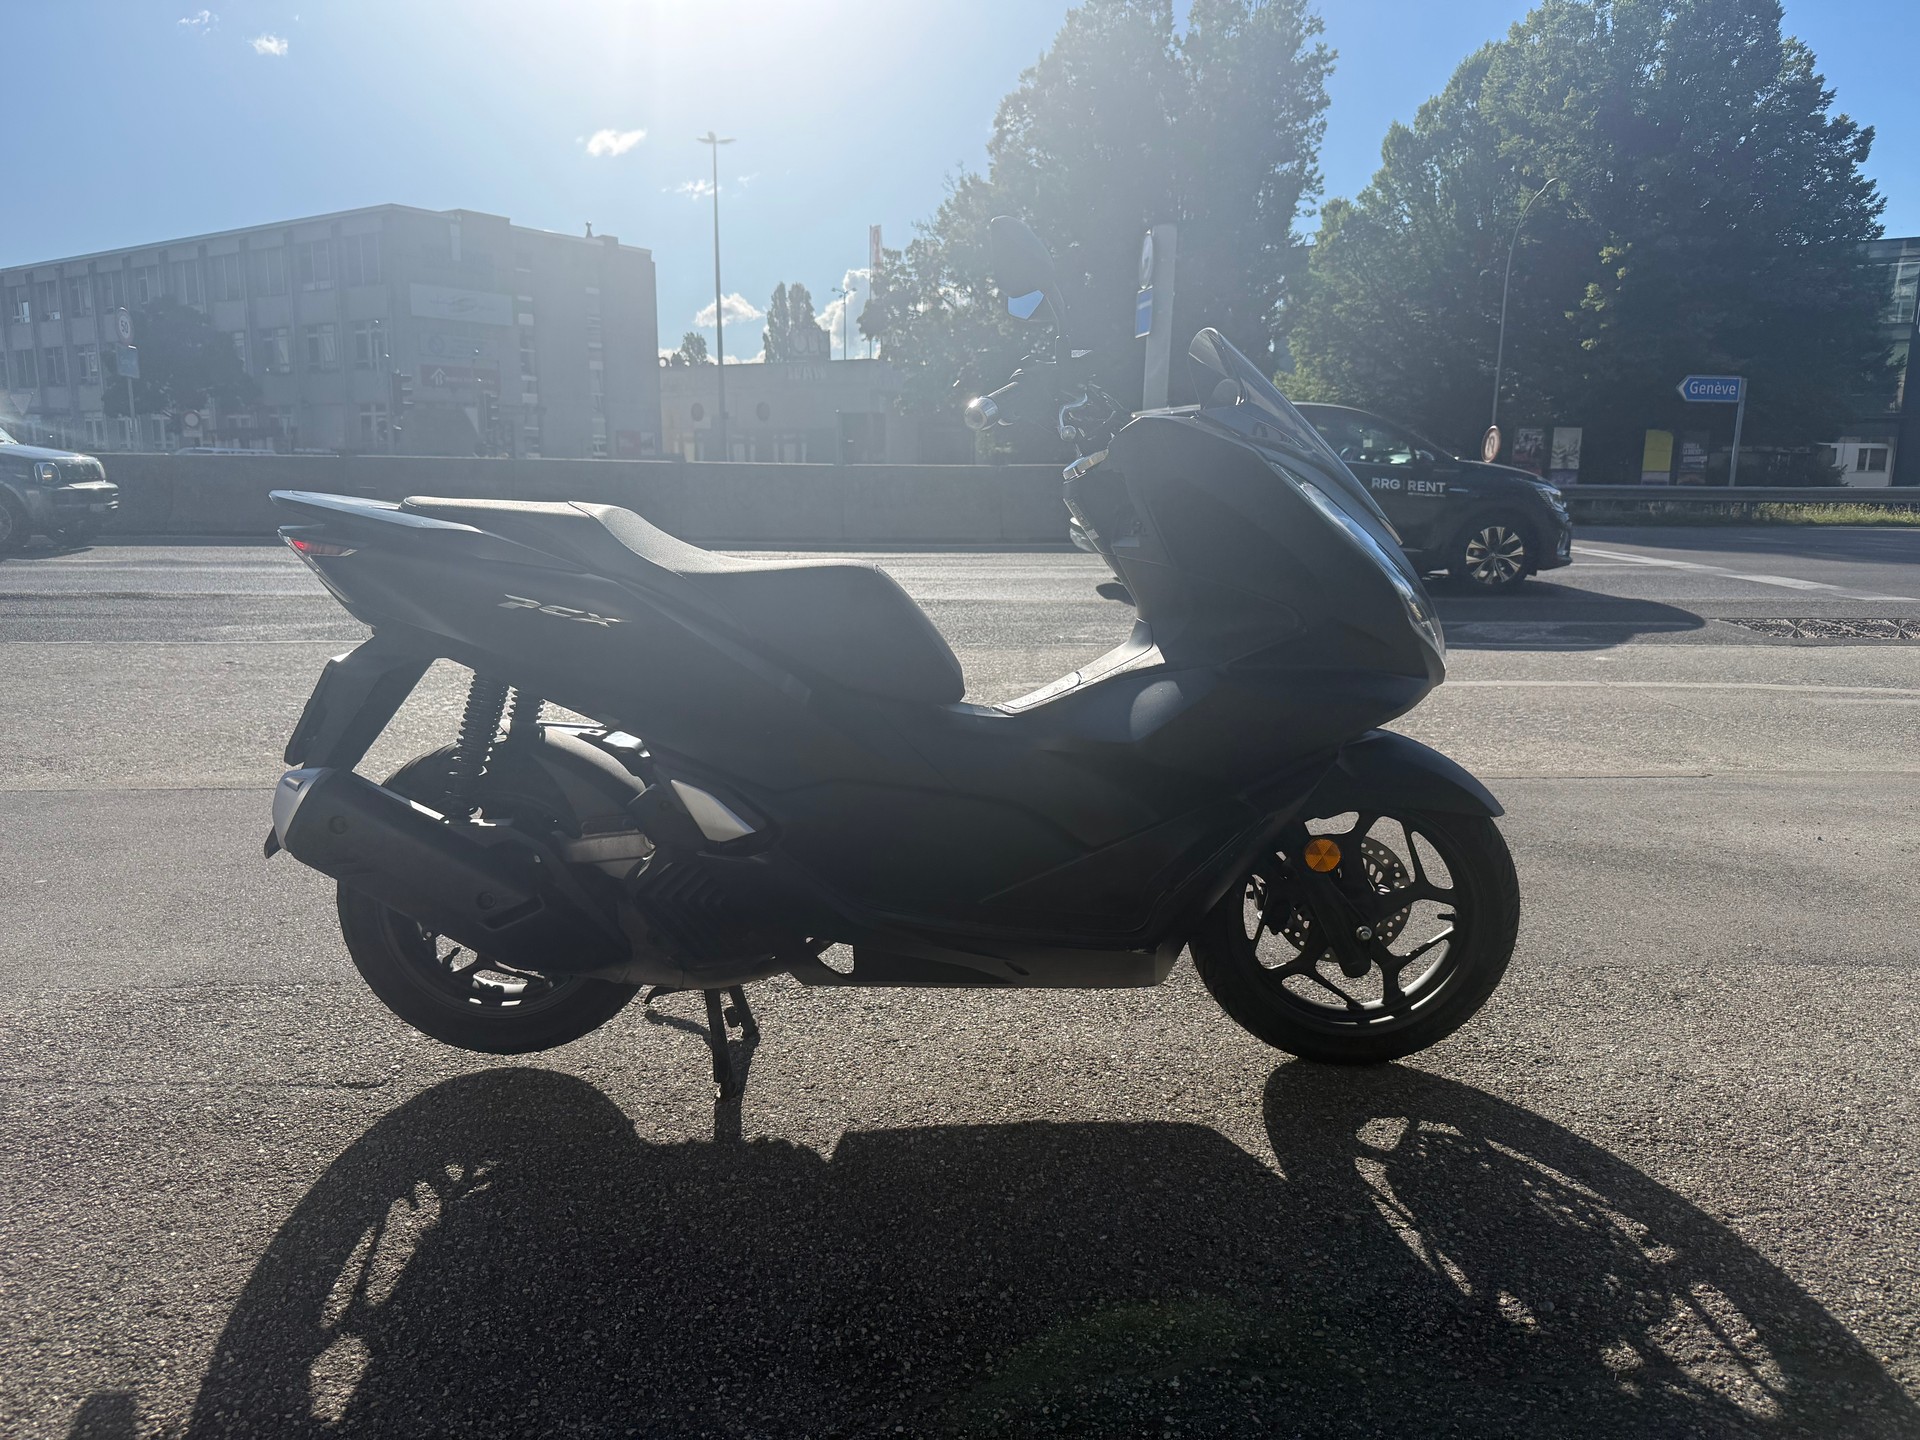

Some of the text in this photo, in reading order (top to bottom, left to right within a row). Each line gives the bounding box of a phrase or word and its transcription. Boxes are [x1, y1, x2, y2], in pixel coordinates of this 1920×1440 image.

[1689, 381, 1737, 395] Genève
[1371, 477, 1446, 493] RRG RENT
